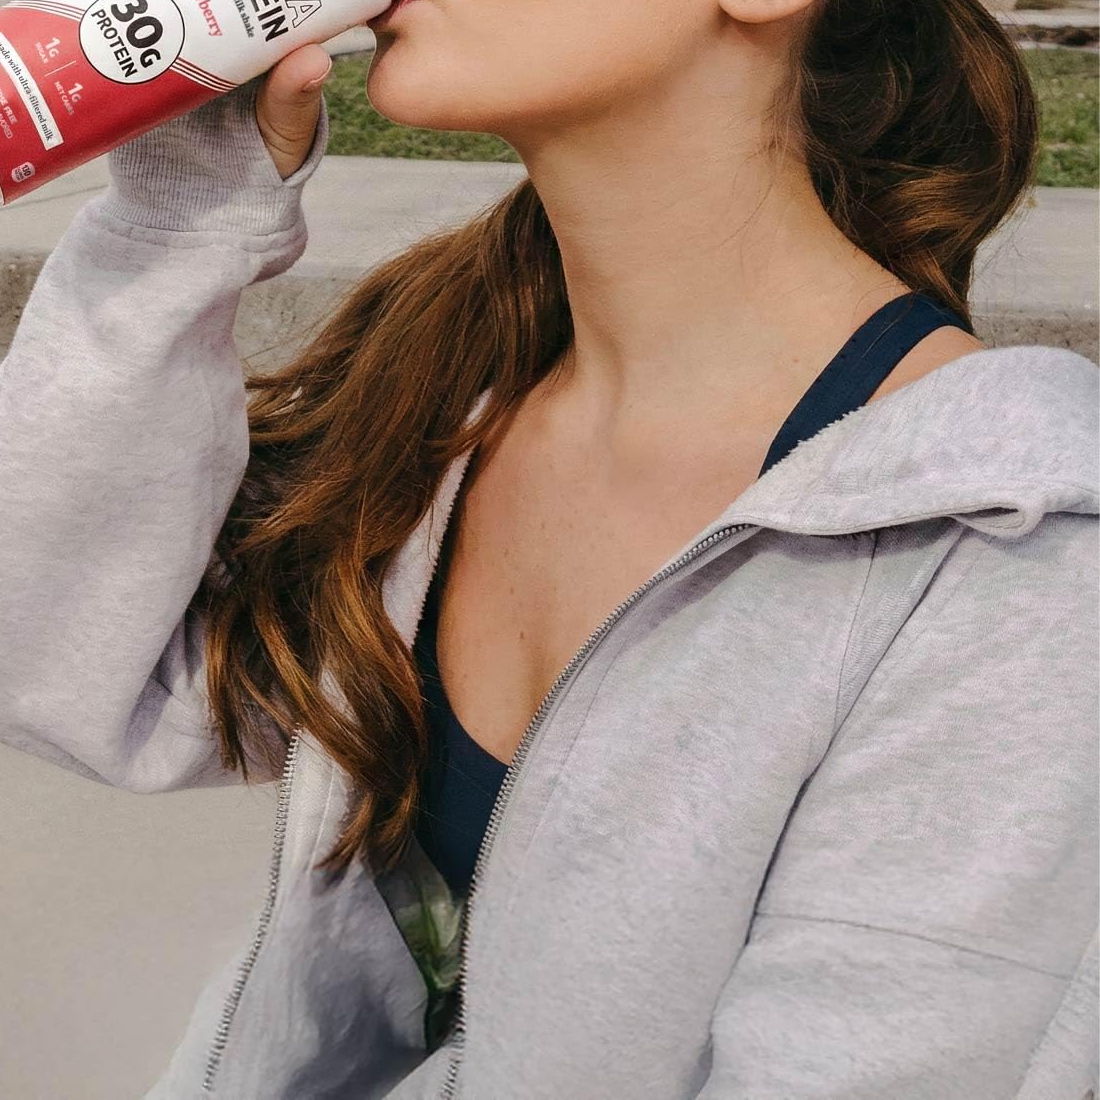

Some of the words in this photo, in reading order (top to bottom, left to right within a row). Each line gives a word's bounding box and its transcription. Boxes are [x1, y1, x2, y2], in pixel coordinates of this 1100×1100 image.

[240, 12, 254, 38] shake
[34, 42, 48, 63] SUGAR
[44, 36, 60, 58] 1G
[90, 9, 138, 78] PROTEIN
[53, 80, 64, 95] NET
[67, 82, 83, 102] 1G
[8, 59, 23, 76] with
[18, 75, 47, 123] ultra-filtered
[41, 122, 53, 141] milk
